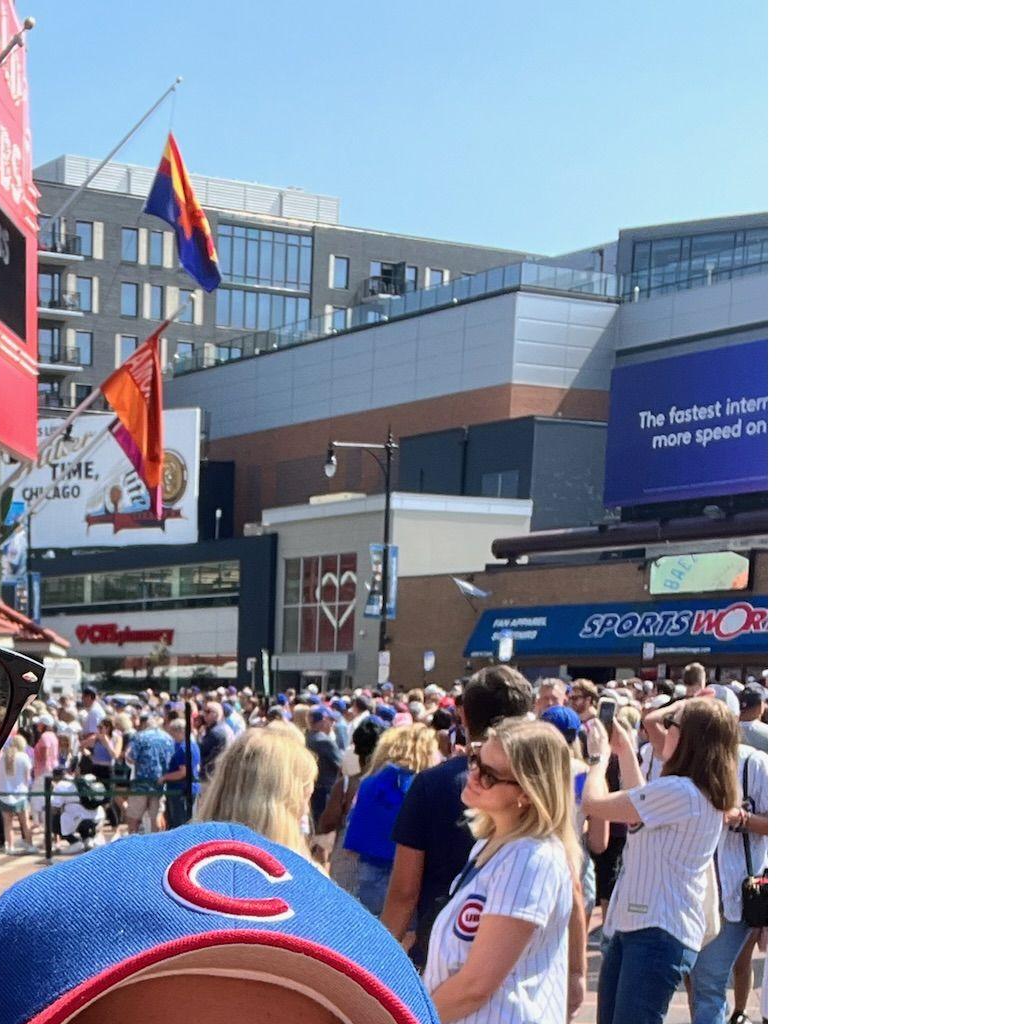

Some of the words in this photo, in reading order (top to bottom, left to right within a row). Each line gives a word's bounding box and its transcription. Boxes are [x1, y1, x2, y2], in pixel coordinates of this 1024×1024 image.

[639, 410, 666, 429] The
[669, 405, 722, 424] fastest
[652, 431, 693, 449] more
[695, 418, 742, 448] speed
[746, 419, 767, 436] on
[161, 838, 296, 923] C
